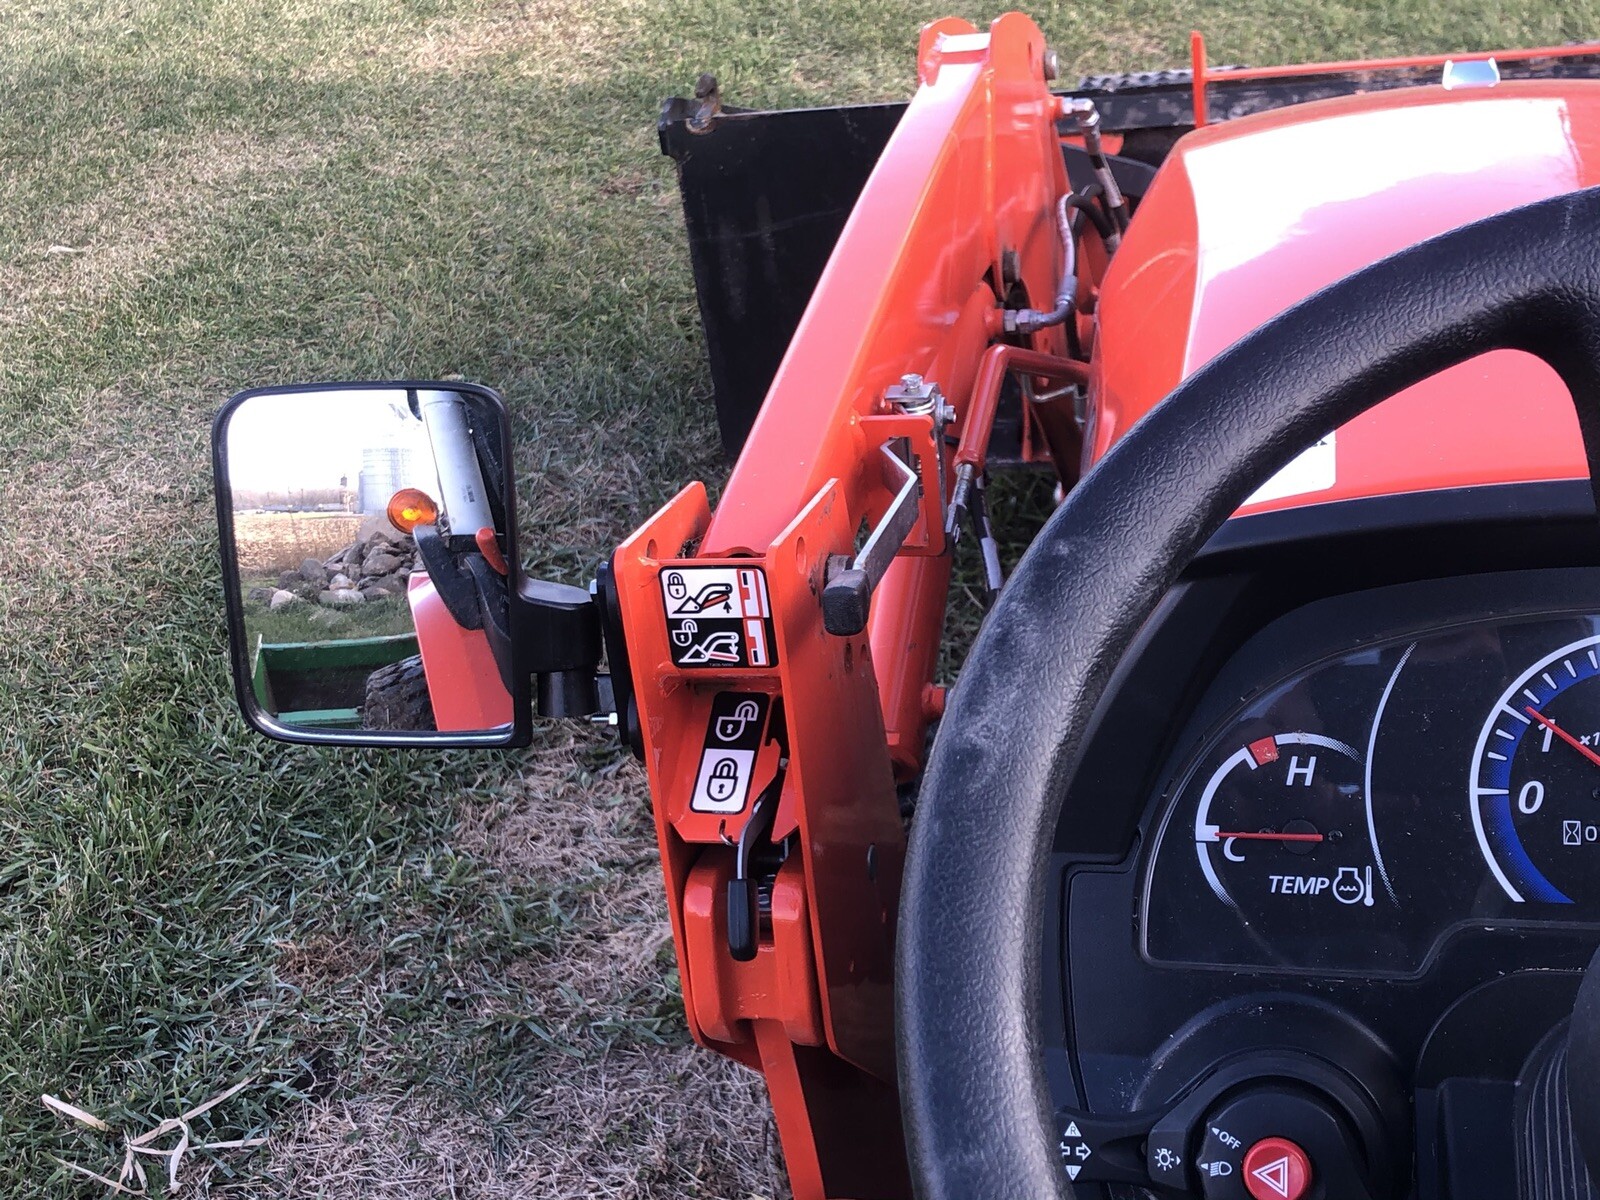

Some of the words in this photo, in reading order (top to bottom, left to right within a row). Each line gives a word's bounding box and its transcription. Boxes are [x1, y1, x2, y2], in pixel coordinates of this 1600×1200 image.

[1286, 756, 1317, 786] H
[1518, 780, 1545, 815] 0
[1223, 831, 1246, 862] C
[1269, 875, 1330, 895] TEMP
[1219, 1131, 1242, 1150] OFF
